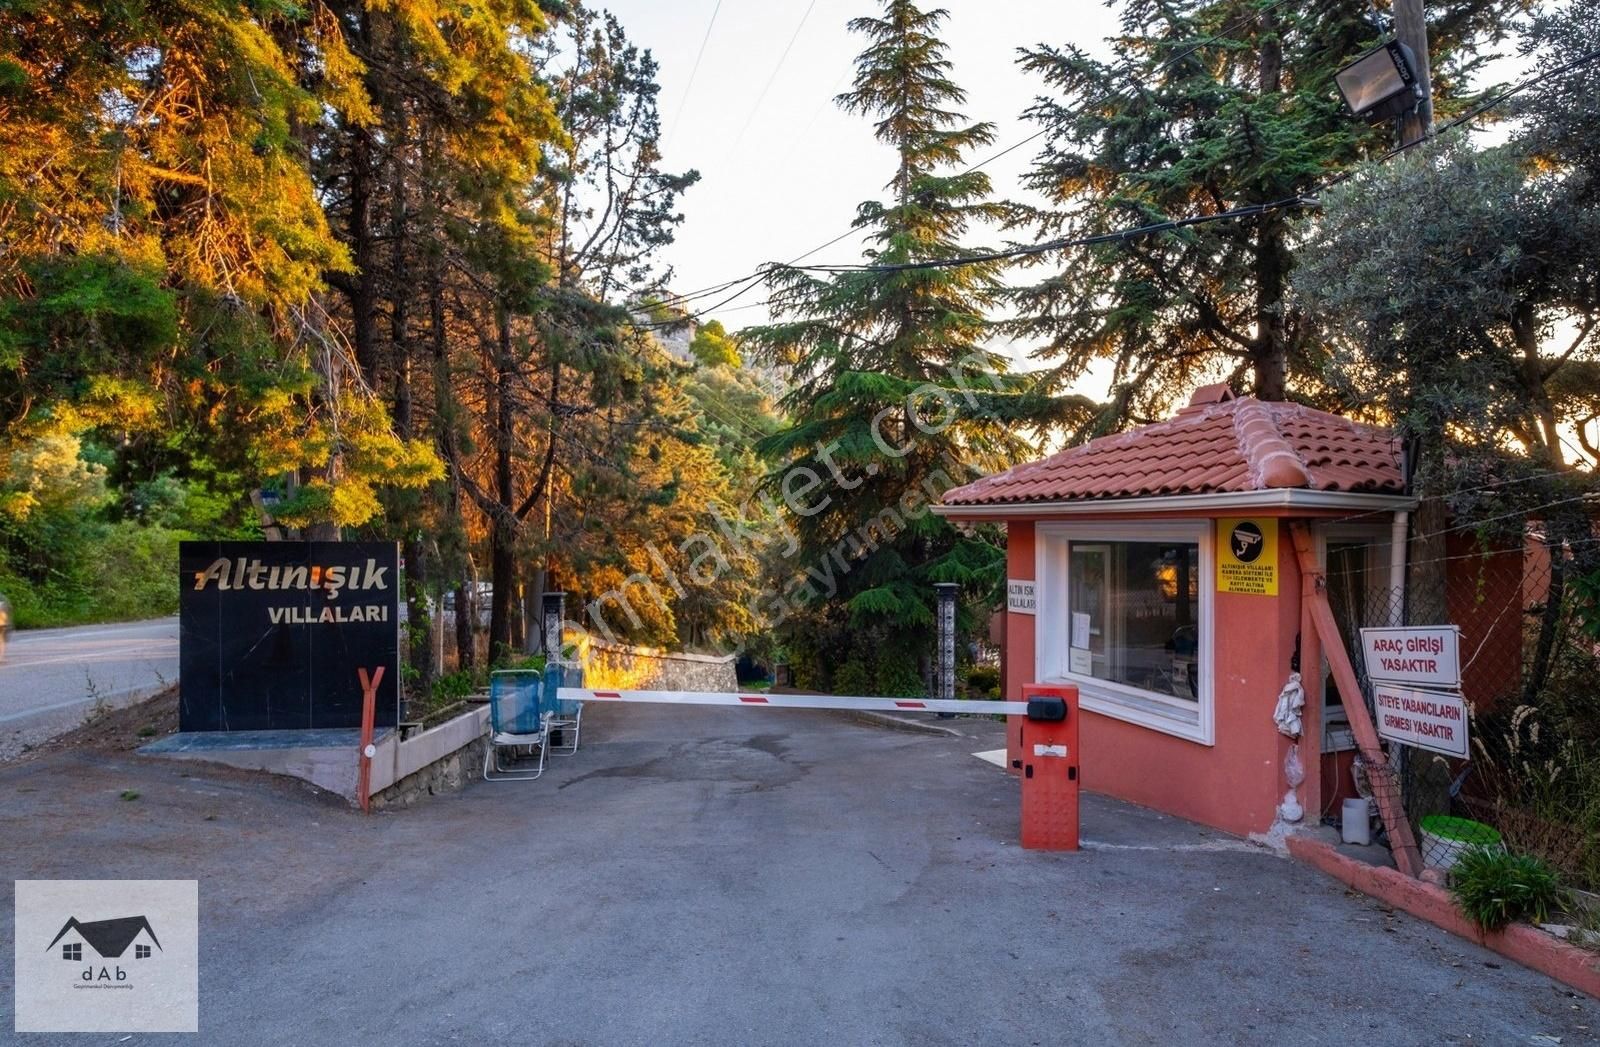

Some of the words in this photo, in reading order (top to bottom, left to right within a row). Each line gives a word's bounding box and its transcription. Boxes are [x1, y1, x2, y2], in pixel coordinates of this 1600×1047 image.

[194, 557, 388, 600] Altınışık
[268, 605, 388, 624] VILLALARI
[1374, 639, 1403, 655] ARAÇ
[1406, 636, 1444, 655] GİRİŞİ
[1381, 658, 1437, 673] YASAKTIR
[1400, 697, 1461, 721] YABANCILARIN
[1414, 721, 1454, 741] YASAKTIR
